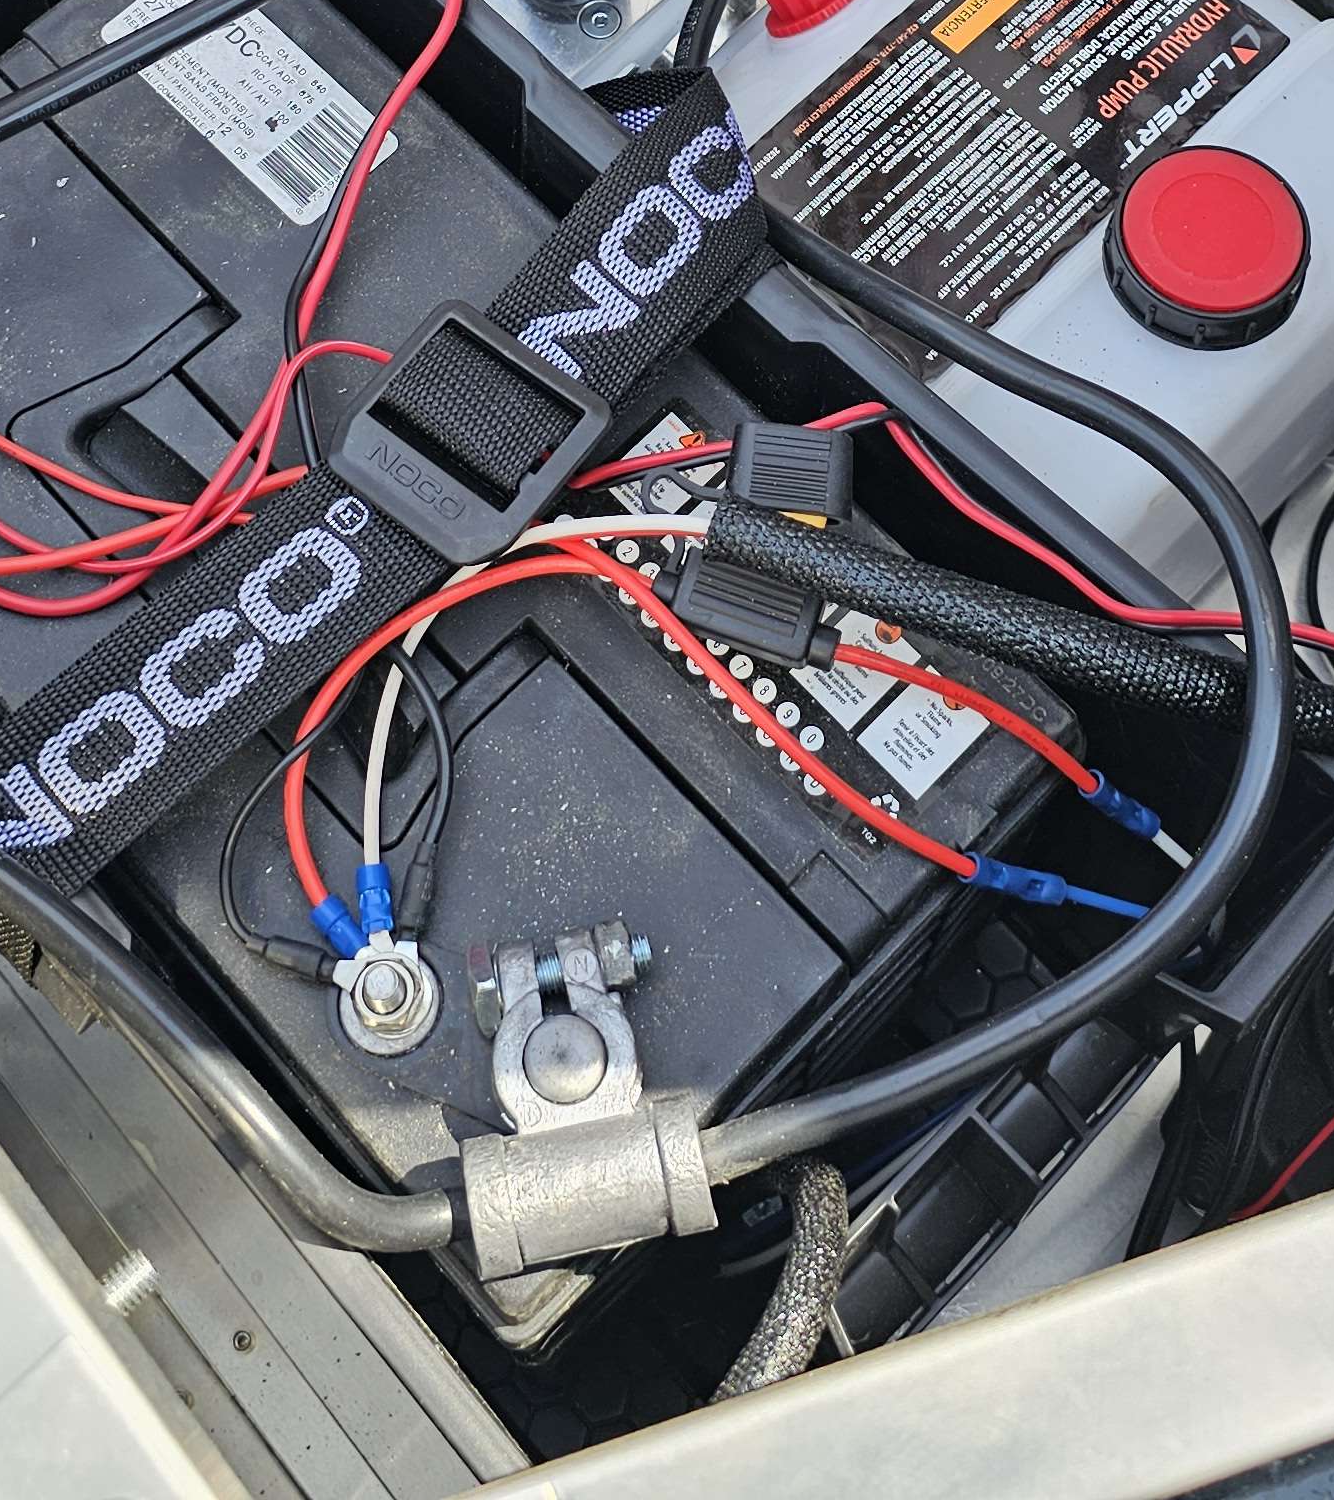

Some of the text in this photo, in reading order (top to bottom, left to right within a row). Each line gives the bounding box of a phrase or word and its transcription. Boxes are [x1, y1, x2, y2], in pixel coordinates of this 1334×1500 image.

[130, 6, 150, 24] FRE
[1067, 37, 1103, 69] DOBLE
[1118, 20, 1165, 62] ACTING
[1036, 61, 1076, 98] EFECTO
[1069, 51, 1108, 87] DOUBLE
[183, 70, 208, 94] SANS
[204, 90, 231, 115] FRAIS
[206, 76, 249, 116] (MONTHS)
[1036, 80, 1076, 117] ACTION
[1091, 67, 1150, 121] PUMP
[214, 119, 232, 136] 12
[1070, 119, 1103, 150] MOTOR
[518, 106, 755, 381] NOC
[364, 438, 468, 523] NOCO
